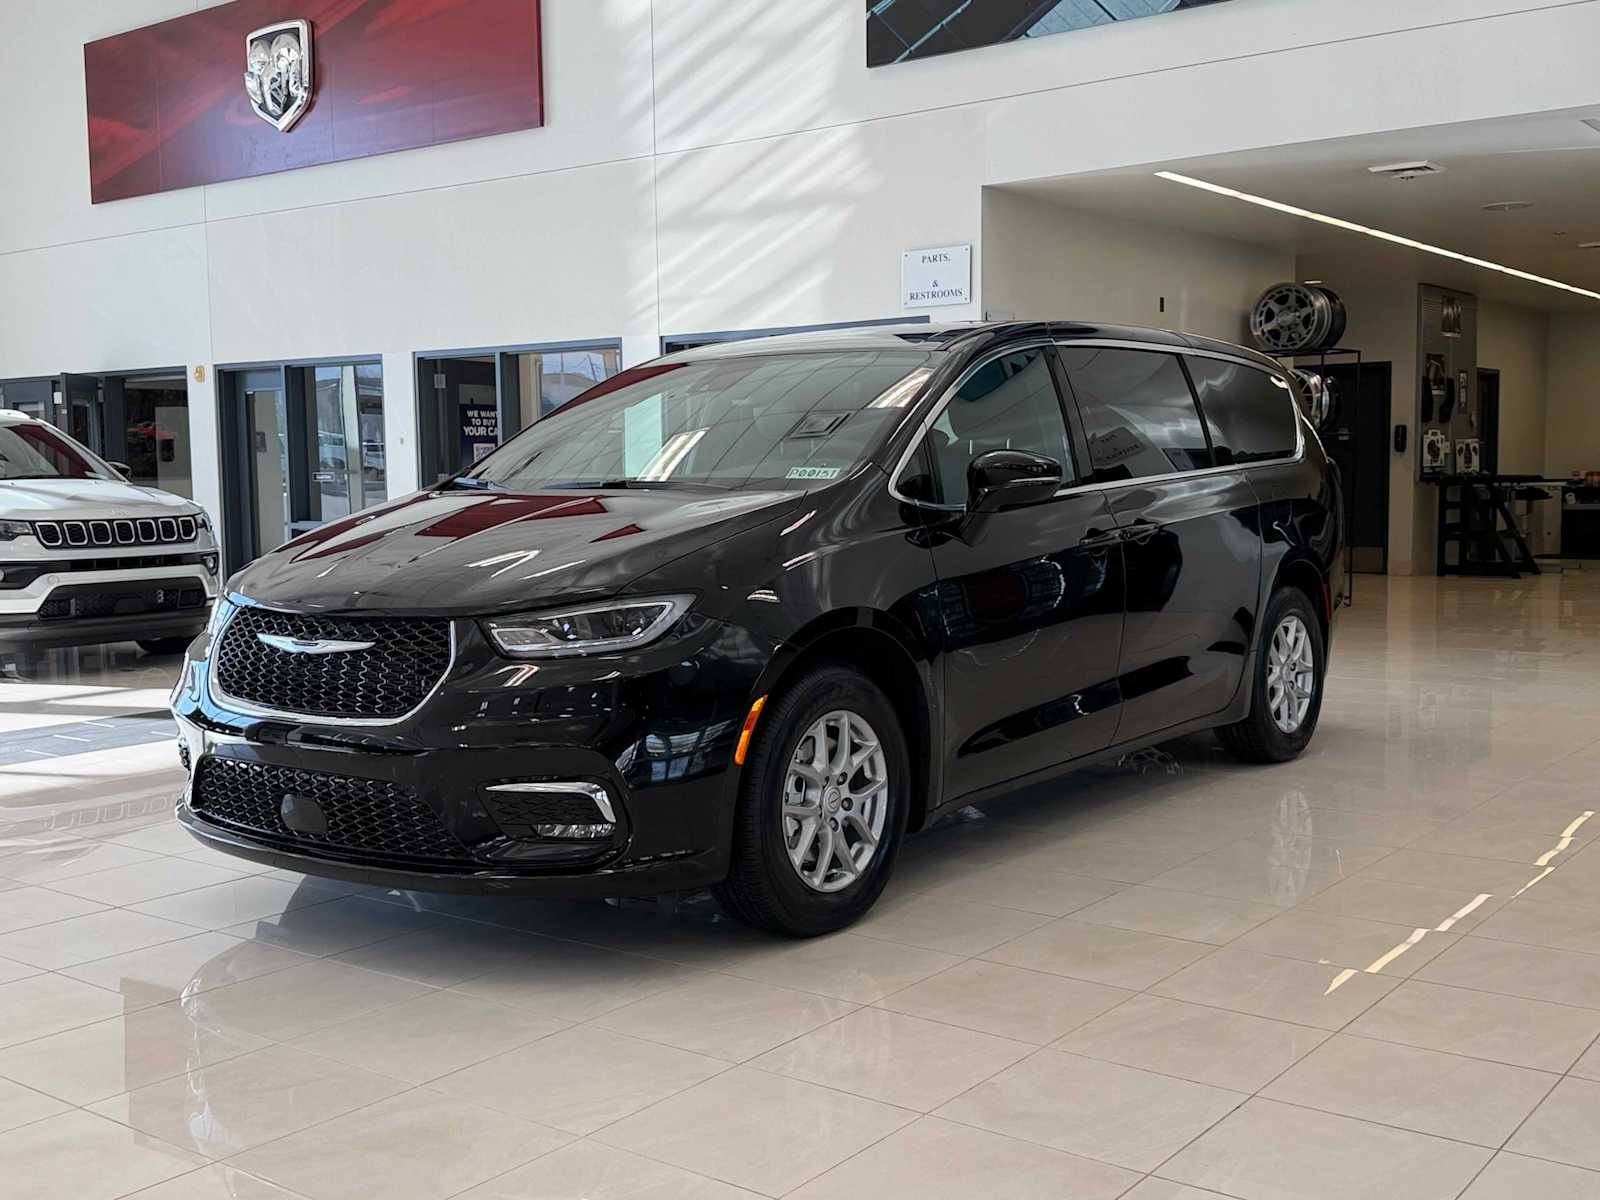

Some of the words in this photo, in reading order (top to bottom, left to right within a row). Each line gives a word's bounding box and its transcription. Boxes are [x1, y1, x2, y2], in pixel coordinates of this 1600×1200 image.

[909, 288, 963, 301] RESTROOMS
[466, 410, 479, 418] WE
[480, 410, 497, 418] WAN
[471, 418, 482, 426] TO
[463, 426, 487, 436] YOUR
